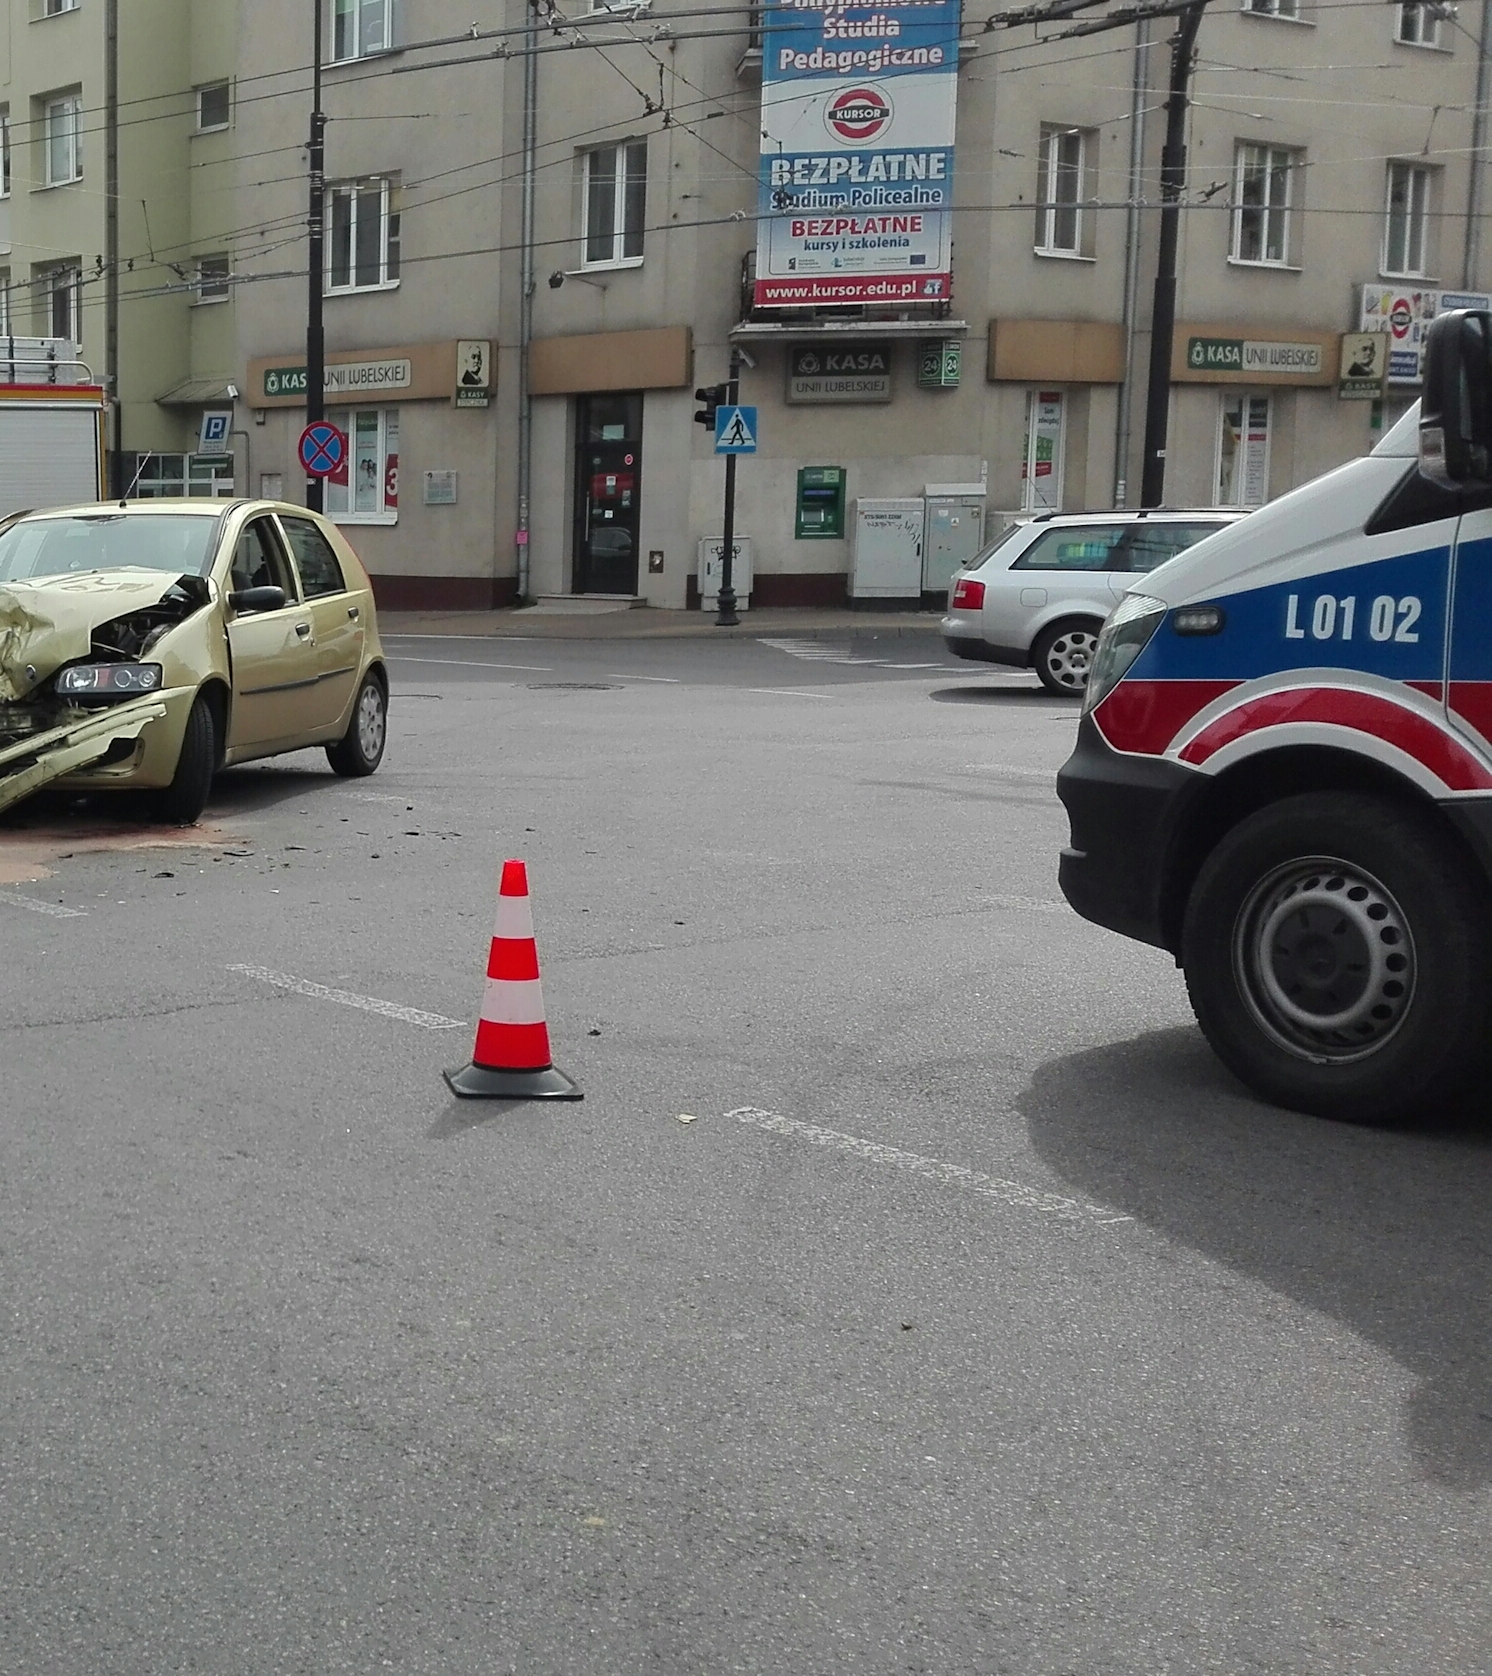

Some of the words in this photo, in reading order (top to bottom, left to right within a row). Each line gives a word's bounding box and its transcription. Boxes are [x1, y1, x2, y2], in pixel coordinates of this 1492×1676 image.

[823, 15, 901, 39] Studia
[780, 44, 943, 72] Pedagogiczne
[836, 109, 882, 120] KURSOR
[770, 152, 946, 187] BEZPŁATNE
[851, 184, 943, 207] Policealne
[791, 215, 923, 237] BEZPŁATNE
[804, 240, 840, 253] kursy
[842, 239, 847, 250] i
[849, 236, 910, 249] szkolenia
[766, 281, 917, 298] www.kursor.edu.pl
[825, 354, 886, 371] KASA
[923, 359, 939, 371] 24
[947, 359, 958, 371] 24
[1208, 346, 1241, 363] KASA
[1246, 349, 1267, 364] UNII
[1270, 350, 1318, 366] LUBELSKIEJ
[281, 372, 308, 389] KAS
[323, 370, 346, 386] UNII
[349, 365, 406, 384] LUBELSKIEJ
[796, 382, 822, 393] UNII
[824, 380, 886, 392] LUBELSKIEJ
[209, 418, 223, 438] P
[1369, 595, 1422, 643] 02
